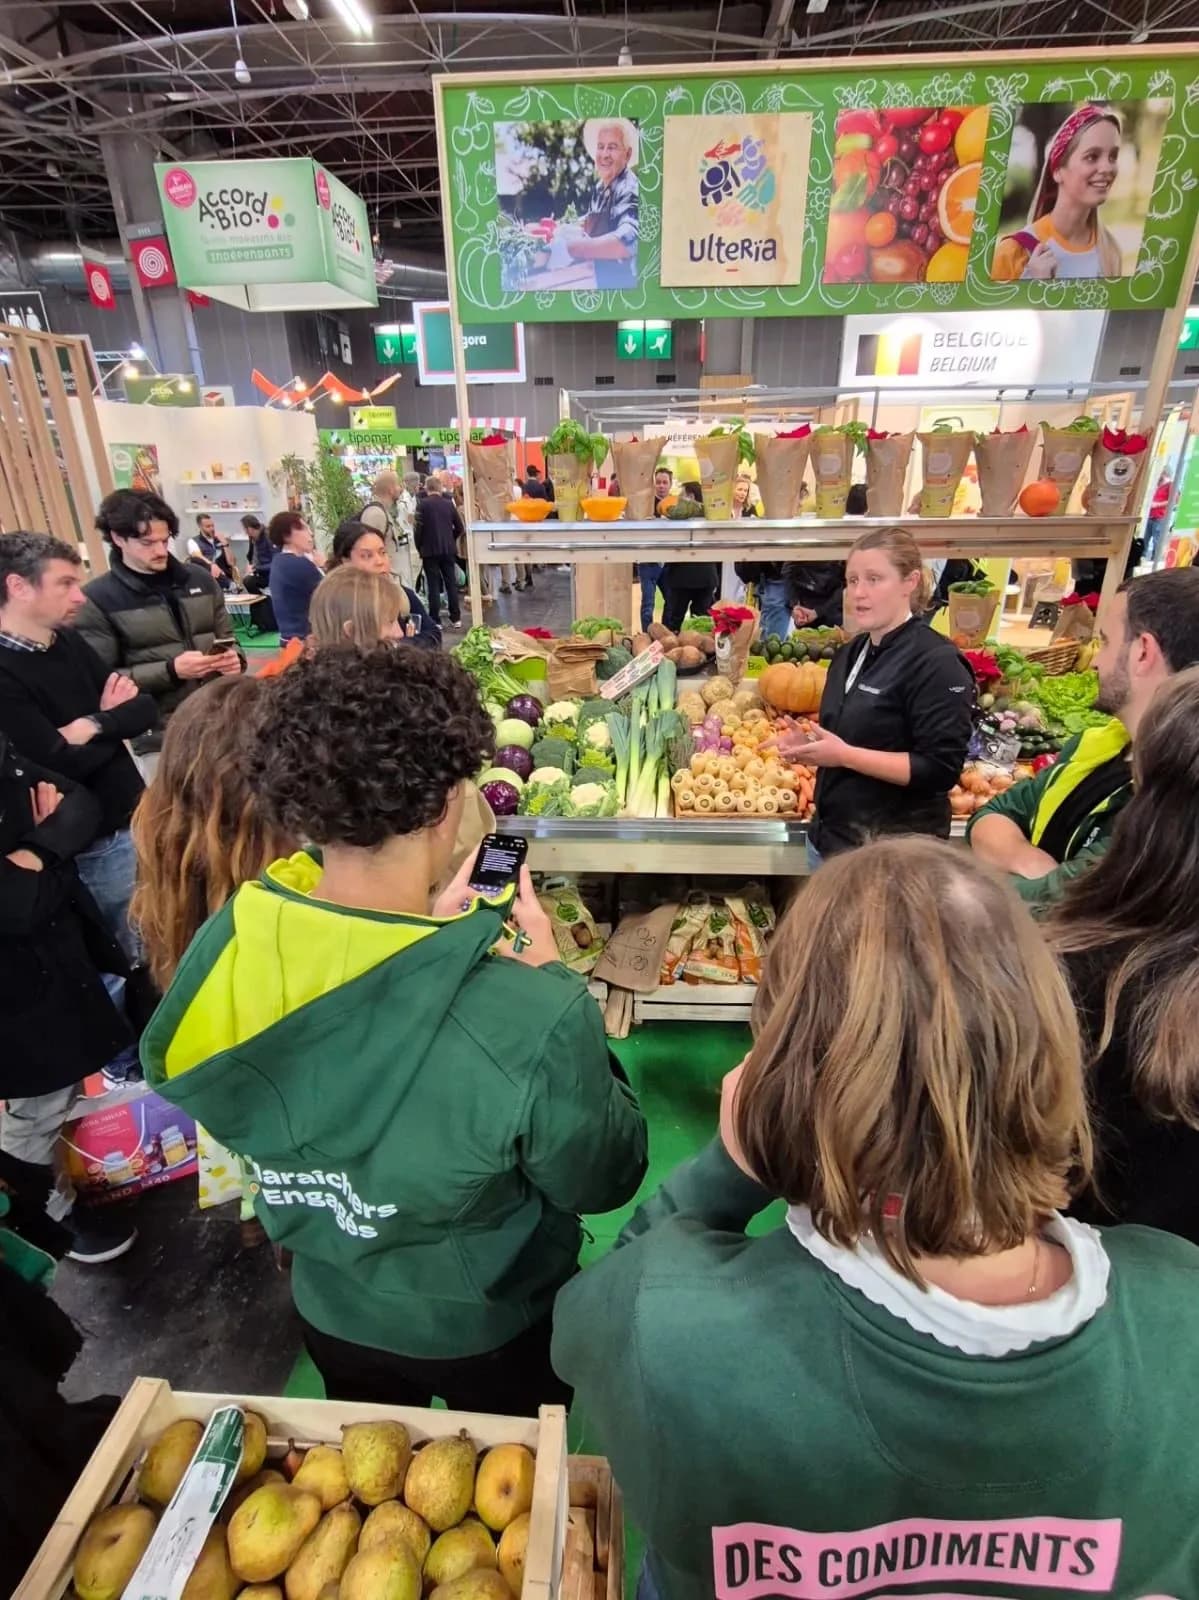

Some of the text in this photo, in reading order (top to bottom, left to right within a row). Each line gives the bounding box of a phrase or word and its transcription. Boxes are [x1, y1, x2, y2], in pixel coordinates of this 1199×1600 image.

[198, 188, 268, 222] Accord
[461, 335, 487, 349] gora
[933, 331, 1029, 348] BELGIQUE
[929, 355, 998, 372] BELGIUM
[349, 432, 393, 445] tipomar
[261, 1188, 379, 1239] Engagés
[724, 1532, 1100, 1589] DES CONDIMENTS
